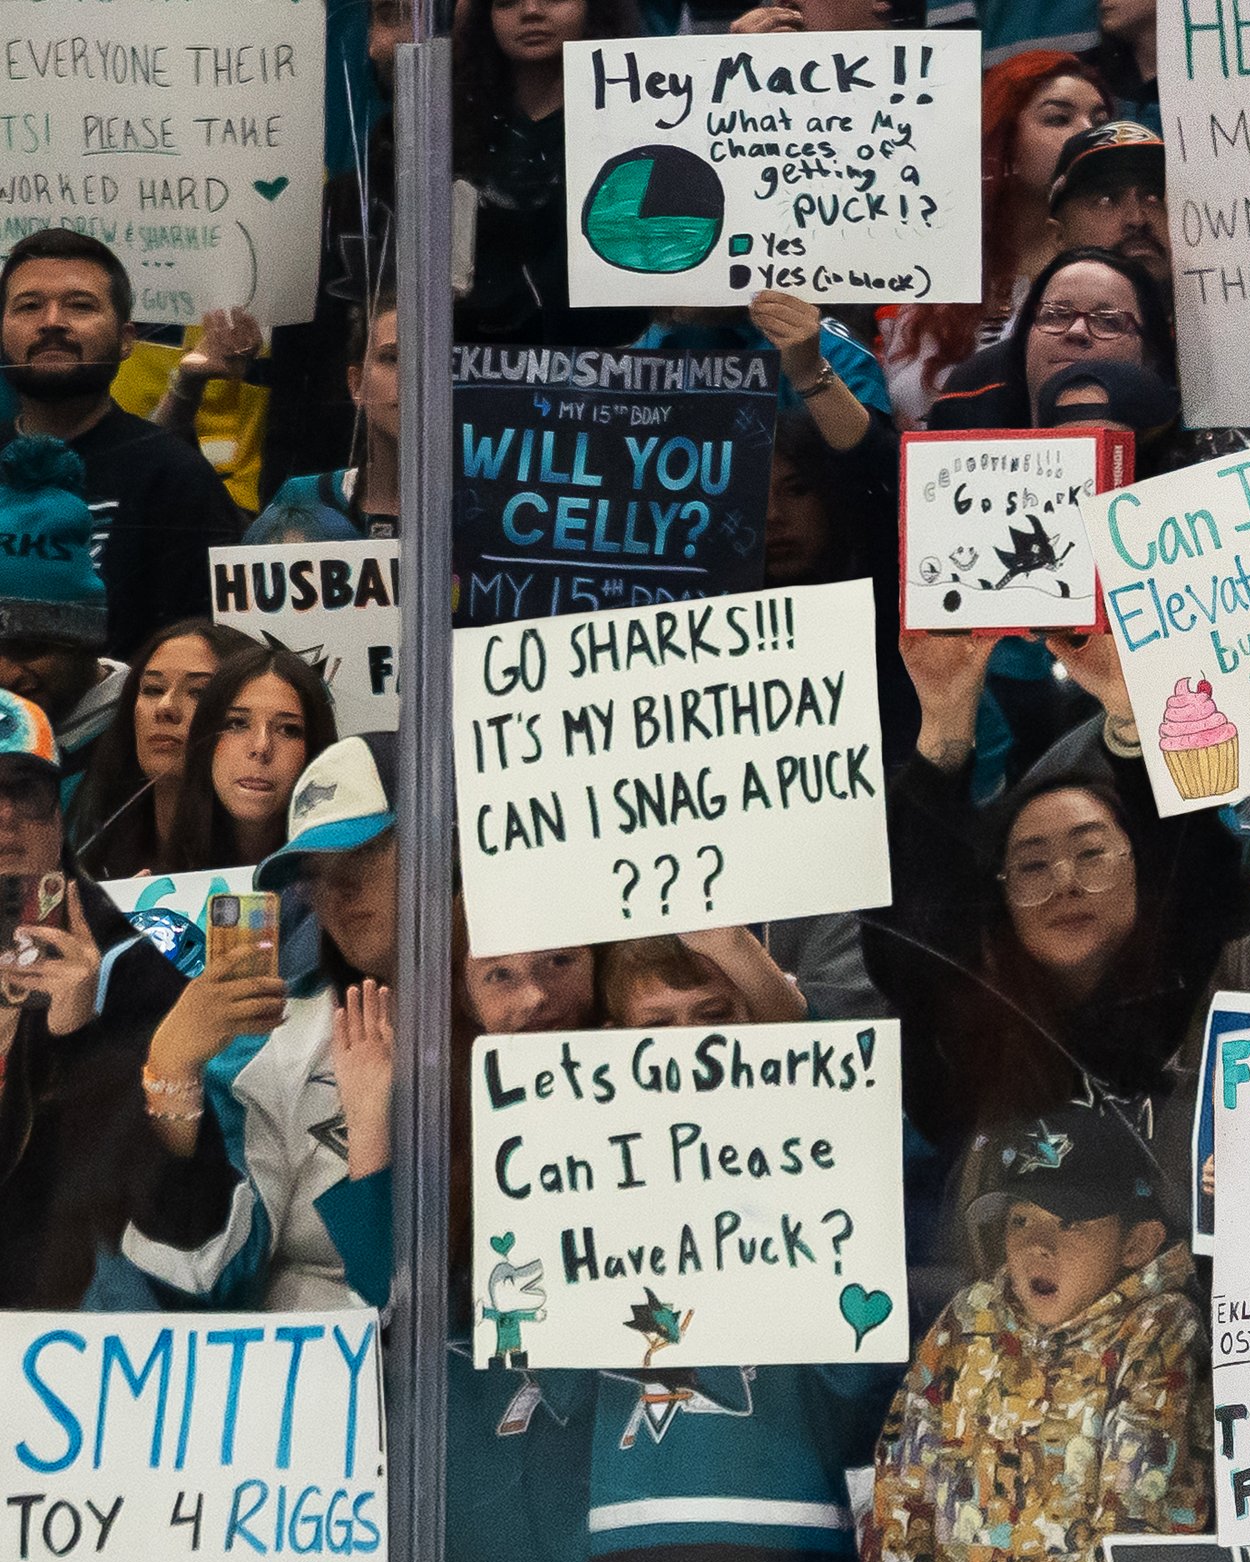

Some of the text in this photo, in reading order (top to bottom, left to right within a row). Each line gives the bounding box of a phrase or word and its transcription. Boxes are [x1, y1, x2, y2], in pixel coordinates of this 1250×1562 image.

[6, 37, 298, 88] EVERYONE THEIR
[591, 48, 694, 129] Hey
[83, 114, 177, 150] PLEASE
[193, 113, 284, 149] TAKE
[707, 110, 794, 138] What
[806, 112, 853, 134] are
[1176, 117, 1188, 161] I
[139, 176, 231, 214] HARD
[755, 160, 922, 200] getting a
[762, 233, 807, 257] Yes
[758, 264, 807, 289] Yes
[558, 400, 585, 420] MY
[462, 422, 734, 496] WILL YOU
[502, 491, 711, 559] CELLY?
[1107, 491, 1223, 572] Can
[214, 557, 399, 614] HUSBA
[470, 571, 534, 618] MY
[483, 597, 796, 697] GO SHARKS!!!
[472, 670, 845, 773] IT'S MY BIRTHDAY
[477, 744, 877, 856] CAN I SNAG A PUCK
[485, 1041, 617, 1111] Lets
[692, 1027, 877, 1093] Sharks!
[495, 1121, 837, 1201] Can I Please
[561, 1225, 667, 1284] Have
[677, 1223, 702, 1276] A
[6, 1478, 382, 1560] TOY 4 RIGGS
